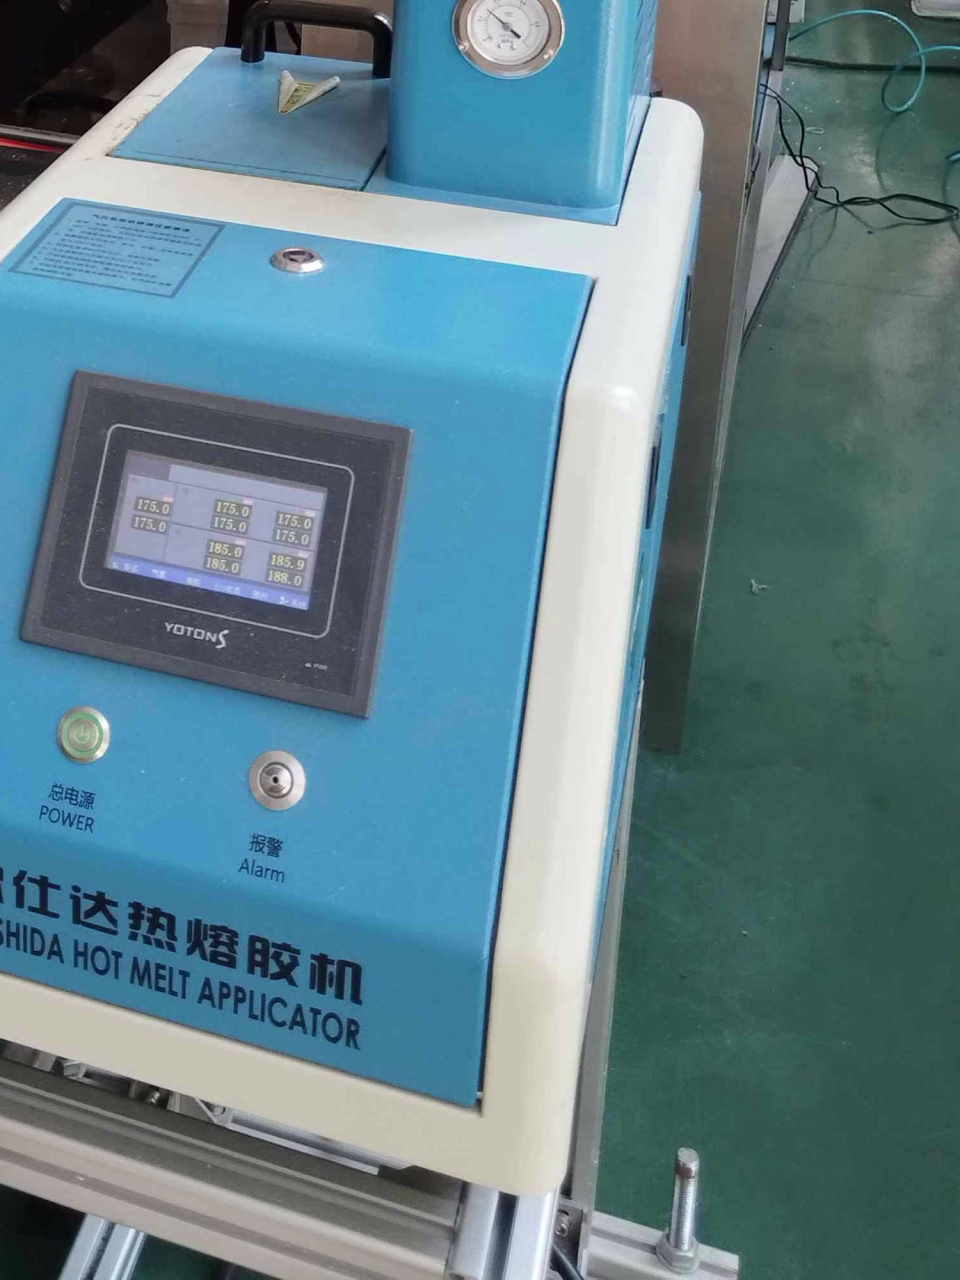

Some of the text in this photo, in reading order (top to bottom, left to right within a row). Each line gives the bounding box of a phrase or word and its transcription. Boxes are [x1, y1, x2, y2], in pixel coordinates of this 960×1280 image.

[137, 498, 170, 514] 175.0
[215, 501, 250, 517] 175.0
[133, 516, 167, 532] 175.0
[212, 516, 247, 532] 175.0
[278, 513, 312, 529] 175.0
[275, 529, 310, 545] 175.0
[208, 541, 242, 557] 185.0
[205, 557, 239, 573] 185.0
[270, 554, 305, 570] 185.9
[267, 570, 302, 586] 188.0
[48, 783, 97, 810] 总电源
[39, 805, 95, 834] POWER
[248, 832, 284, 858] 报警
[238, 857, 285, 883] Alarm
[72, 941, 123, 981] HOT
[129, 955, 190, 1000] MELT
[196, 976, 362, 1051] APPLICATOR
